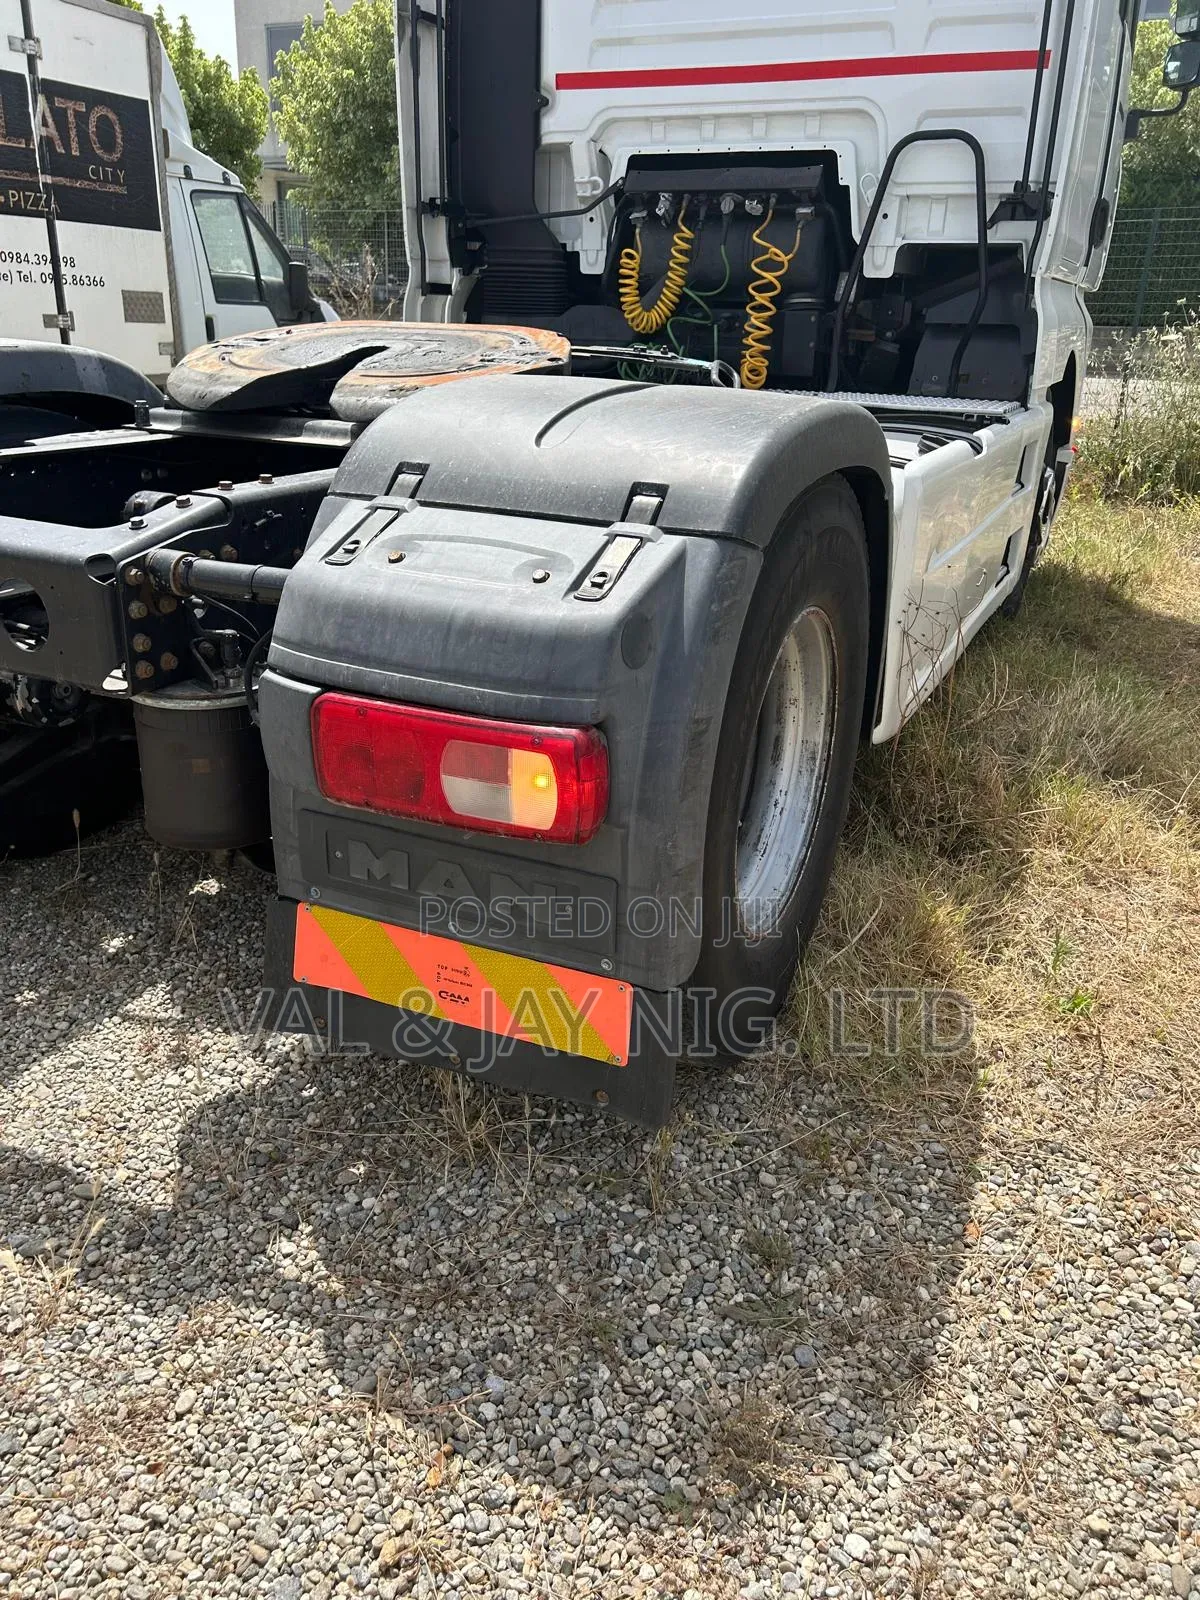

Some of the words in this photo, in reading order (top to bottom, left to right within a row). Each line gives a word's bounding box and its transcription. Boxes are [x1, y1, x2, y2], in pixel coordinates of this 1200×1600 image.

[89, 165, 125, 183] CITY
[0, 251, 76, 268] 0984.3998
[16, 270, 36, 283] Tel.
[40, 272, 105, 287] 095.86366
[348, 839, 557, 921] MAN
